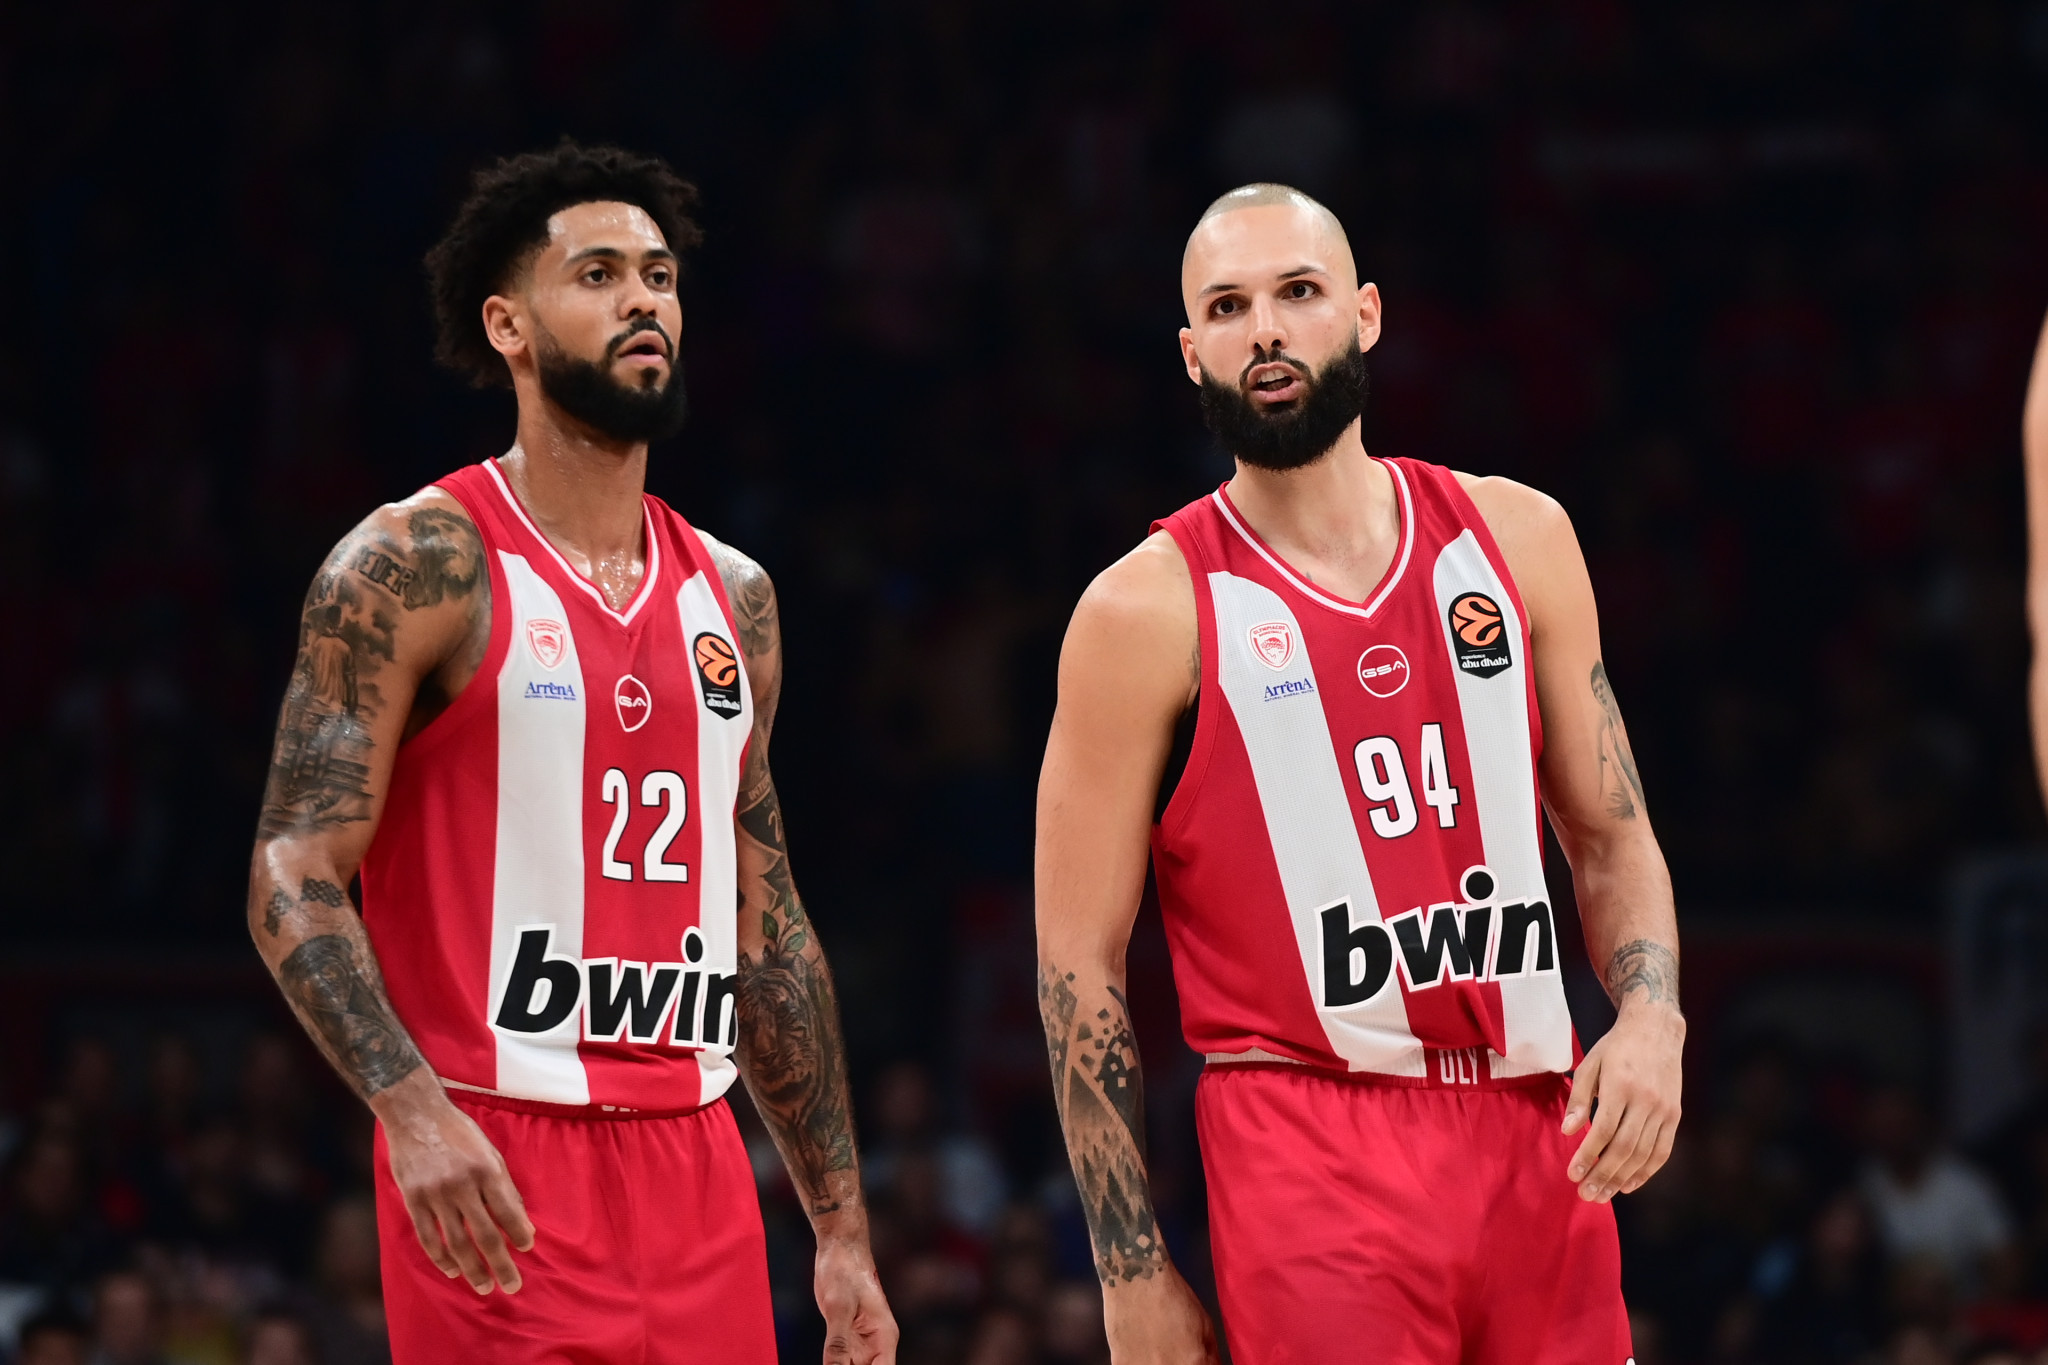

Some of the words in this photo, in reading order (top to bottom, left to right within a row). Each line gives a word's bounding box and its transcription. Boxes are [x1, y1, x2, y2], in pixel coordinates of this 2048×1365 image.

[1362, 660, 1406, 678] GSA
[1462, 659, 1480, 669] abu
[1480, 655, 1509, 668] dhabi
[602, 766, 688, 883] 22
[1353, 722, 1461, 840] 94
[491, 926, 738, 1050] bwin
[1318, 867, 1556, 1010] bwin
